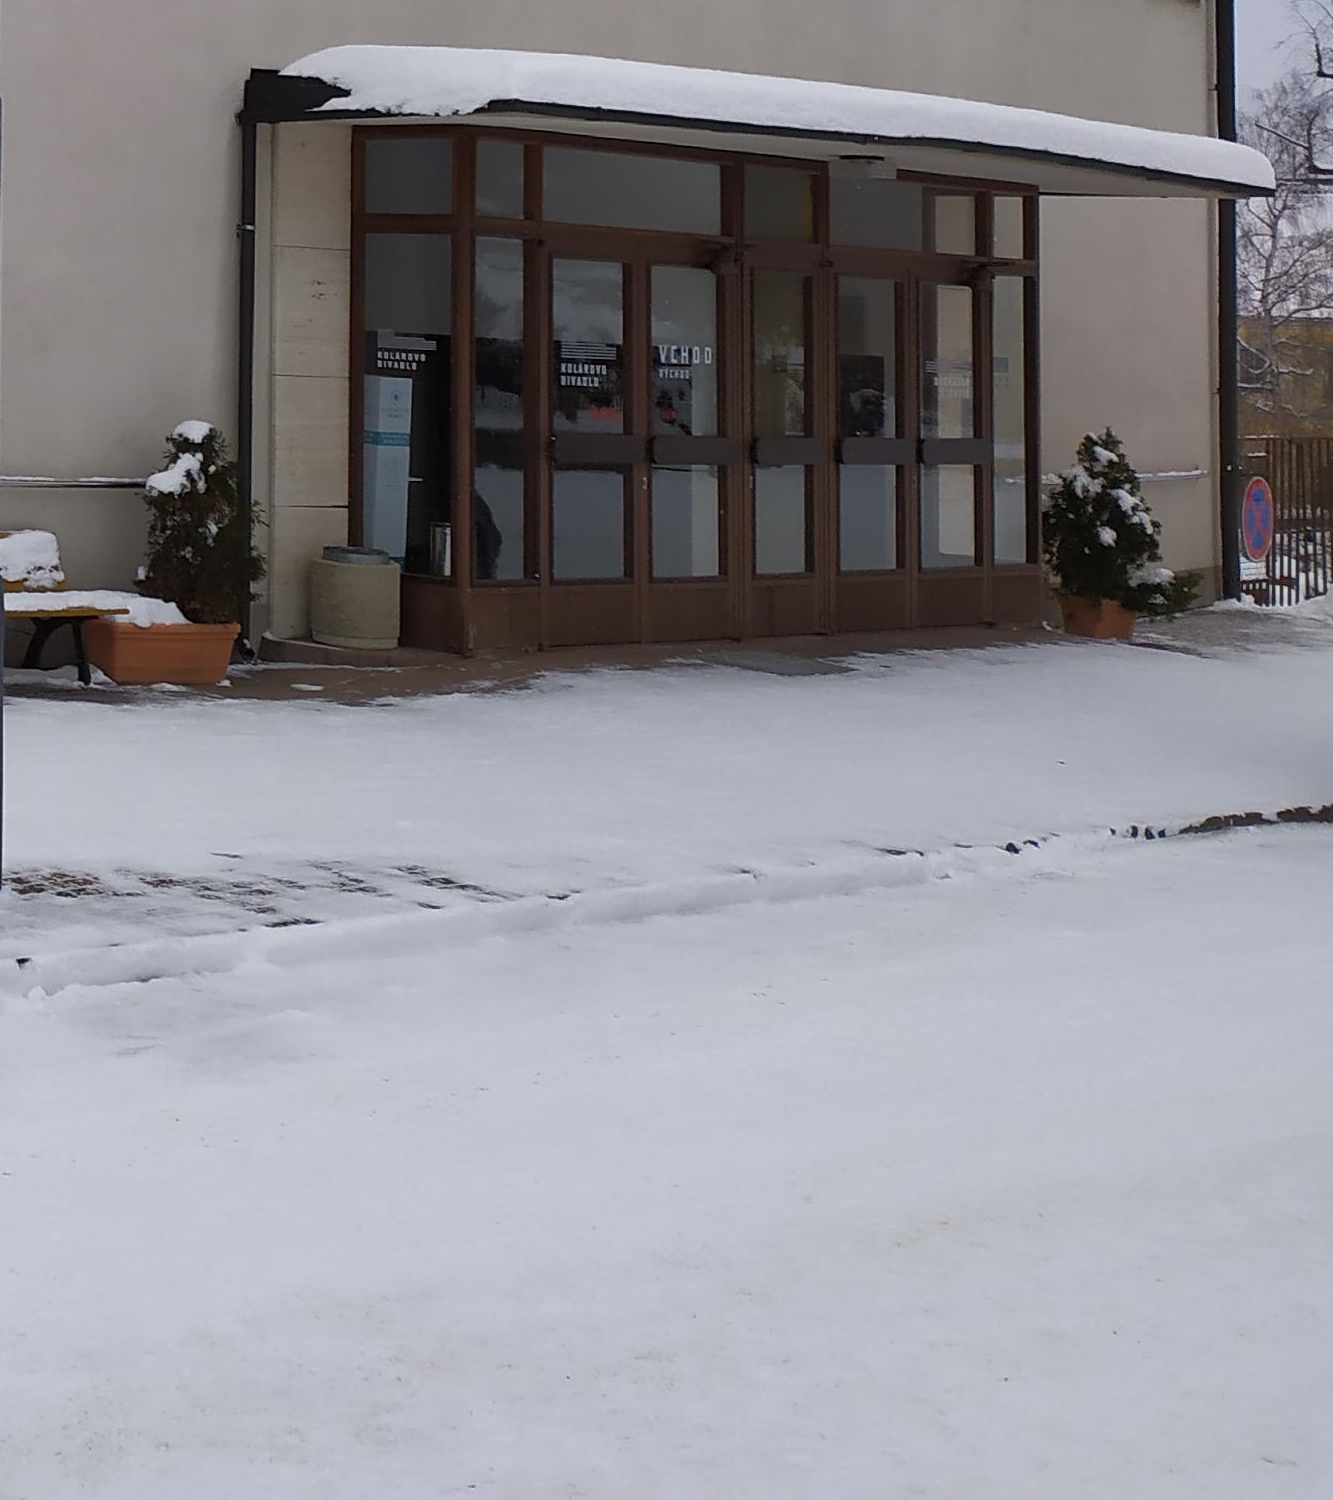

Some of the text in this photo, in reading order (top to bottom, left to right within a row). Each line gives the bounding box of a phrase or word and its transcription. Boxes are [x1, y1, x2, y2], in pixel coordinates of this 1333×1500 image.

[658, 344, 712, 364] VCHOD
[377, 360, 417, 371] DIVADLO
[560, 375, 599, 387] DIVADLO
